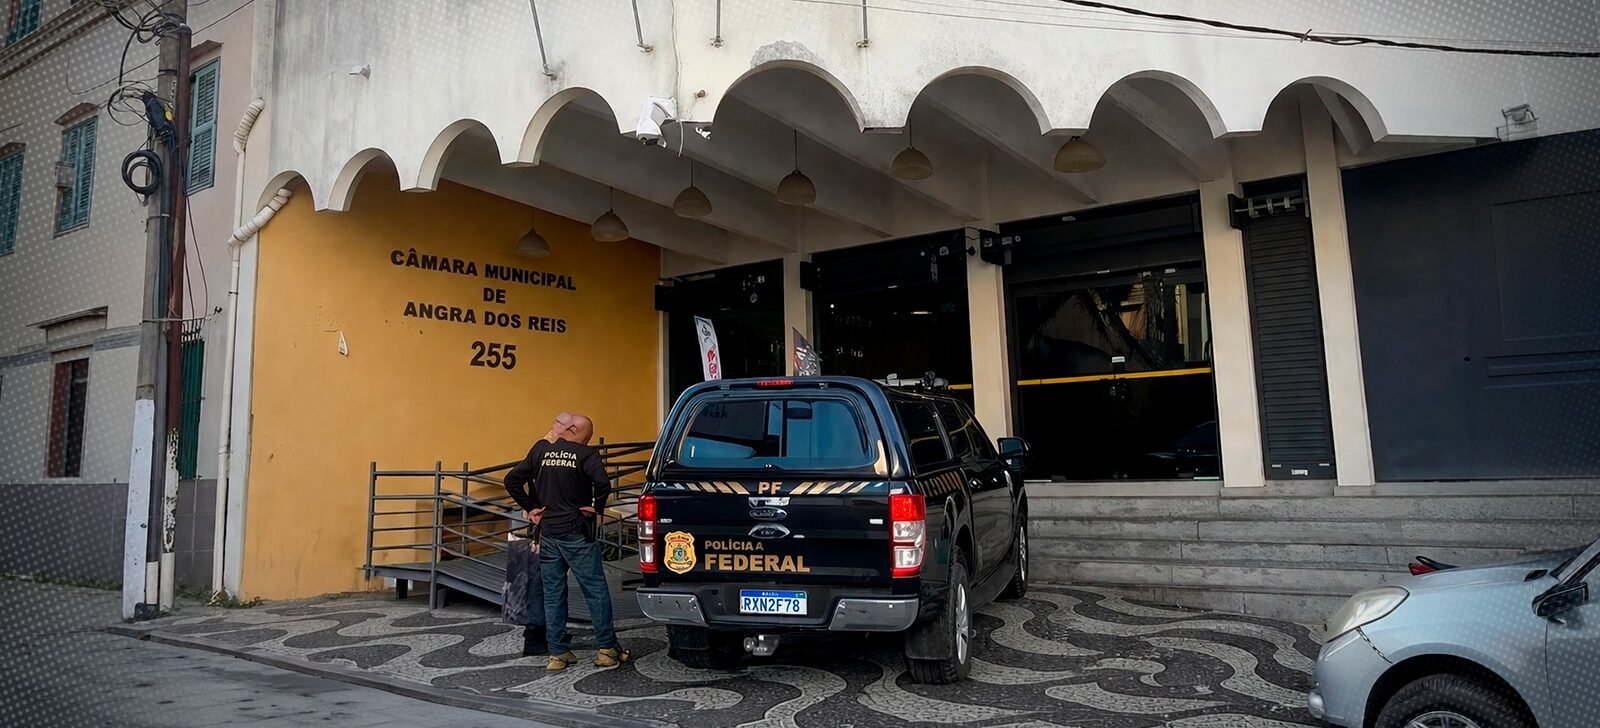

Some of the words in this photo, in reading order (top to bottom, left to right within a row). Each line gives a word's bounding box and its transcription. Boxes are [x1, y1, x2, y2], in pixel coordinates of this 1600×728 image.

[390, 248, 478, 276] CÂMARA
[485, 264, 576, 290] MUNICIPAL
[483, 288, 506, 304] DE
[403, 302, 477, 324] ANGRA
[484, 311, 521, 329] DOS
[528, 316, 567, 333] REIS
[470, 341, 517, 370] 255
[544, 450, 577, 460] POLÍCIA
[541, 459, 577, 468] FEDERAL
[758, 481, 783, 495] PF
[704, 553, 811, 573] FEDERAL
[743, 597, 800, 612] RXN2F78
